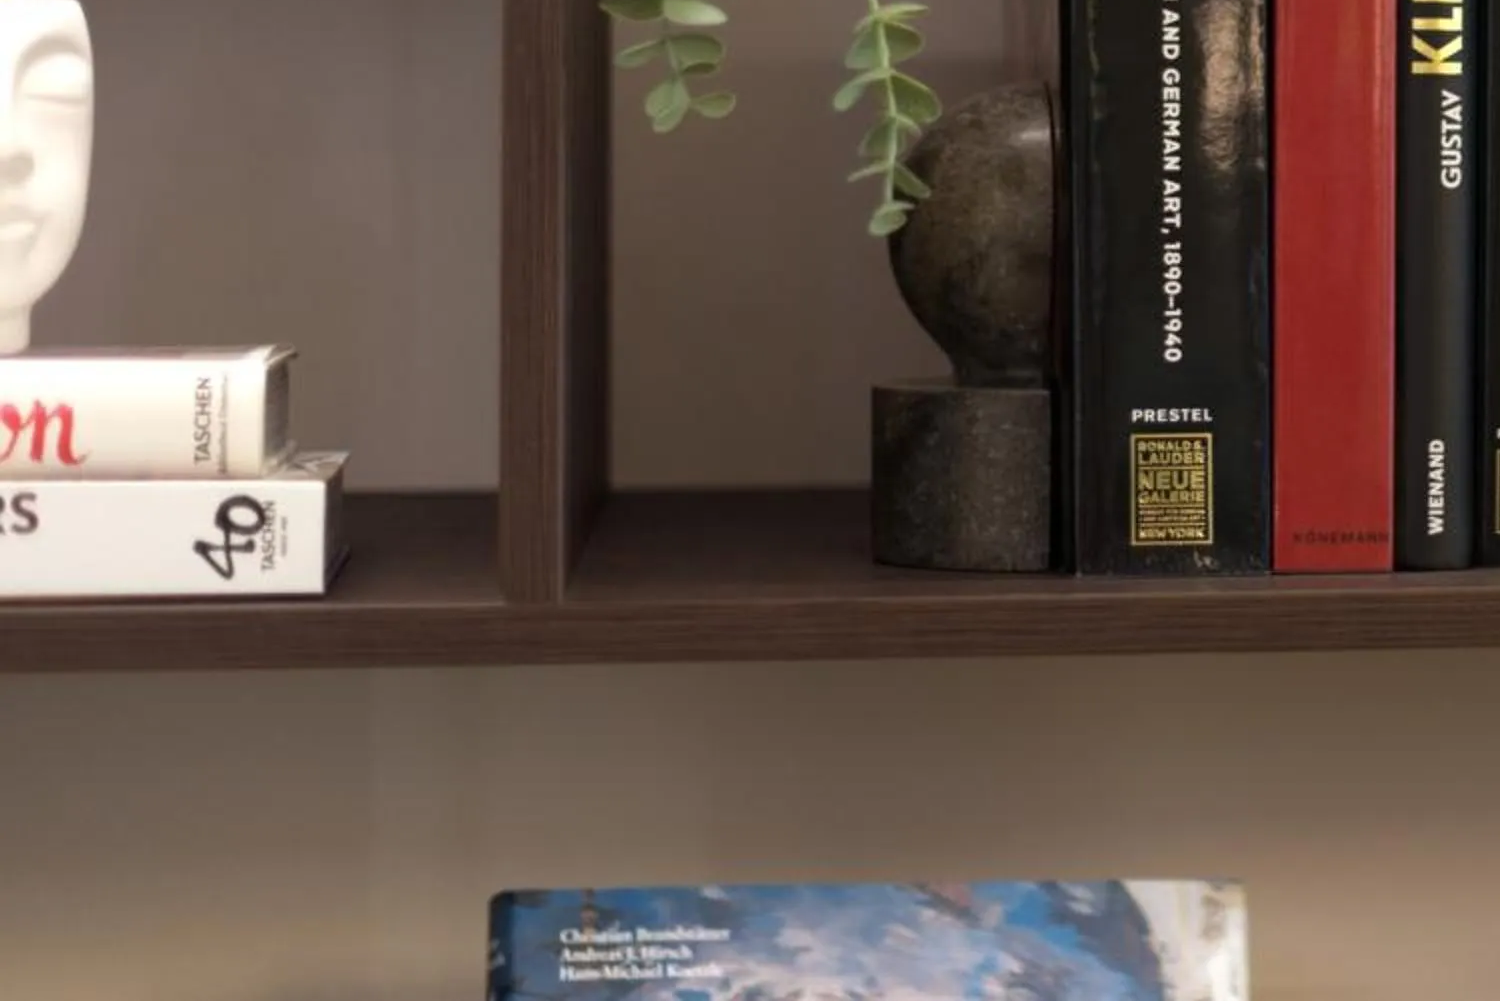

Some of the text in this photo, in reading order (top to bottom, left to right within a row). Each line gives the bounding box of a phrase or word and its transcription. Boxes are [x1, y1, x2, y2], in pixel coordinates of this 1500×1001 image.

[1161, 9, 1181, 60] AND
[1161, 68, 1182, 171] GERMAN
[1440, 90, 1463, 189] GUSTAV
[1159, 179, 1182, 234] ART,
[1162, 241, 1183, 362] 1890–1940
[193, 376, 212, 465] TASCHEN
[1131, 408, 1213, 422] PRESTEL
[1138, 452, 1205, 465] LAUDER
[1138, 470, 1206, 490] NEUE
[1427, 439, 1446, 535] WIENAND
[0, 491, 39, 535] S
[1138, 490, 1206, 504] GALERIE
[193, 495, 267, 579] 40
[260, 500, 277, 572] TASCHEN
